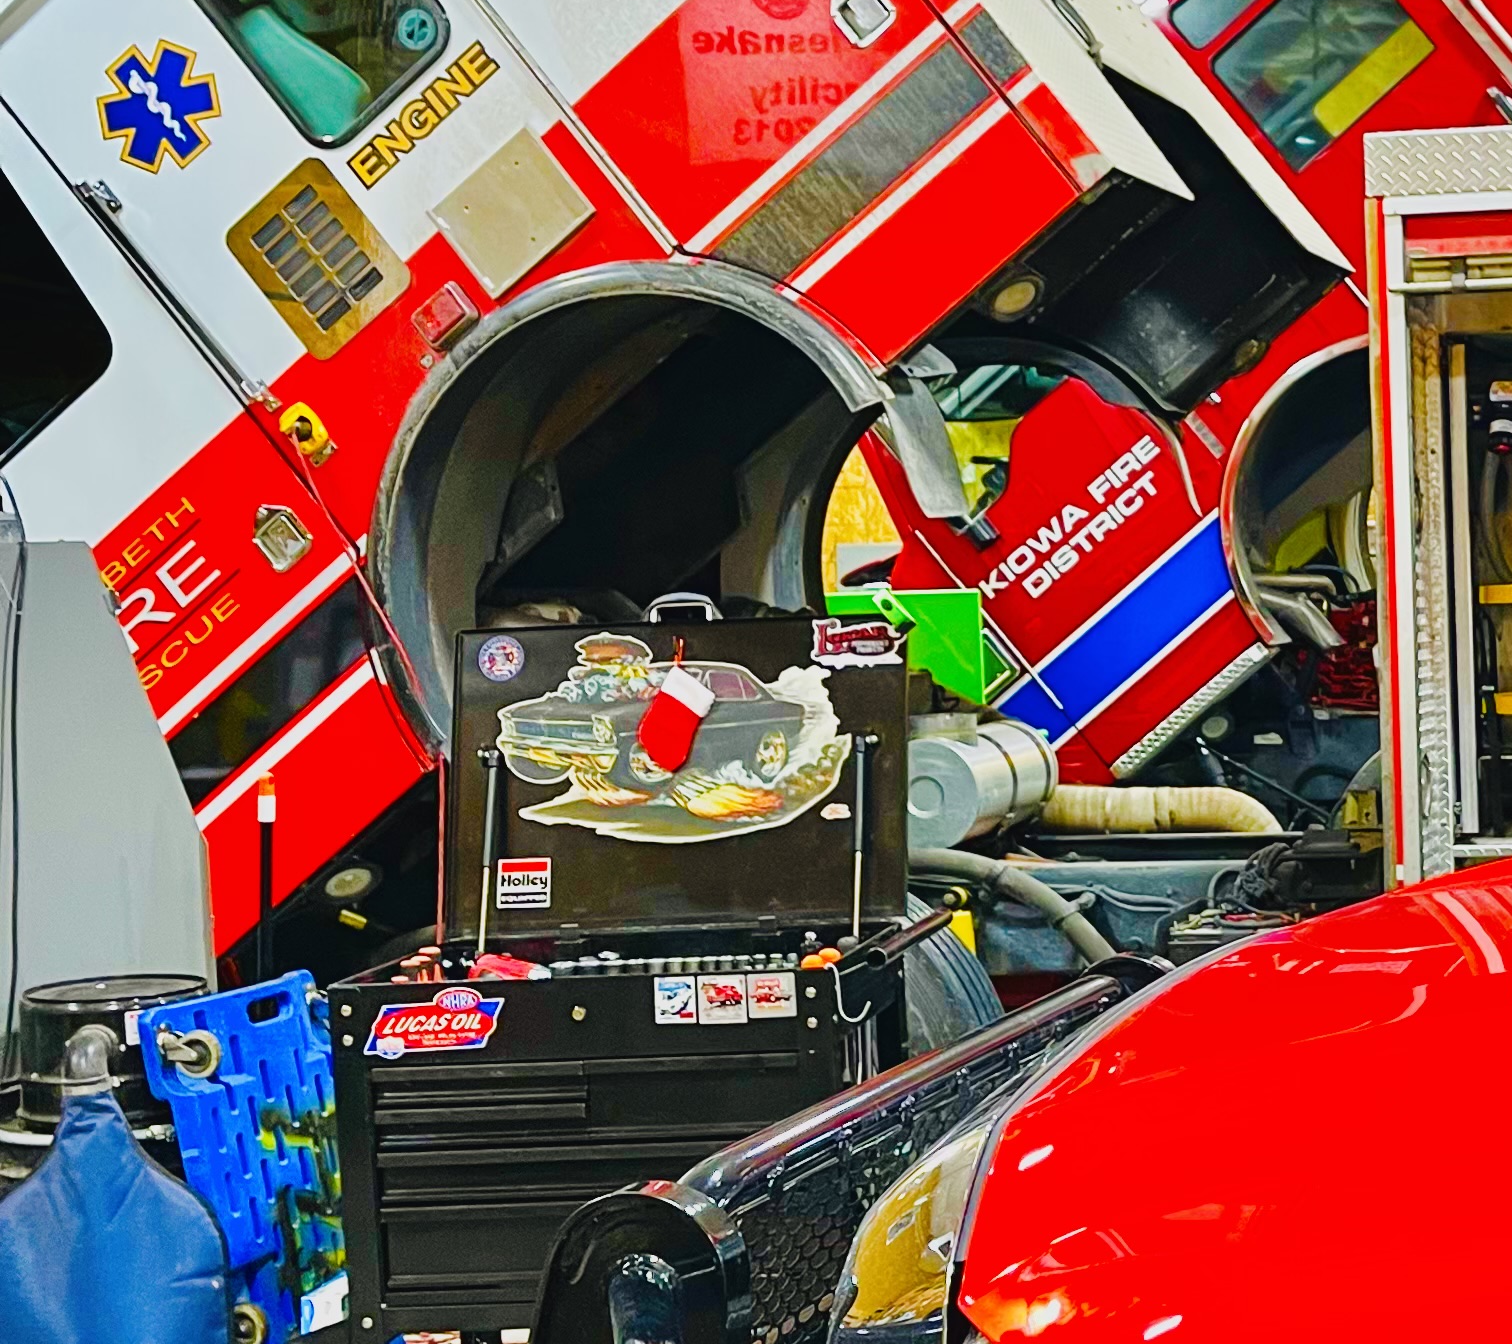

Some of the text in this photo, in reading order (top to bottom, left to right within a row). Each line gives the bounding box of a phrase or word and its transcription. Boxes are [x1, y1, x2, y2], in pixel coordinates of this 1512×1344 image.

[346, 39, 501, 190] ENGINE
[978, 434, 1161, 600] KIOWA FIRE
[1021, 470, 1157, 599] DISTRICT
[500, 873, 548, 890] Holley
[381, 1012, 482, 1035] LUCAS OIL
[441, 992, 475, 1010] NHRA
